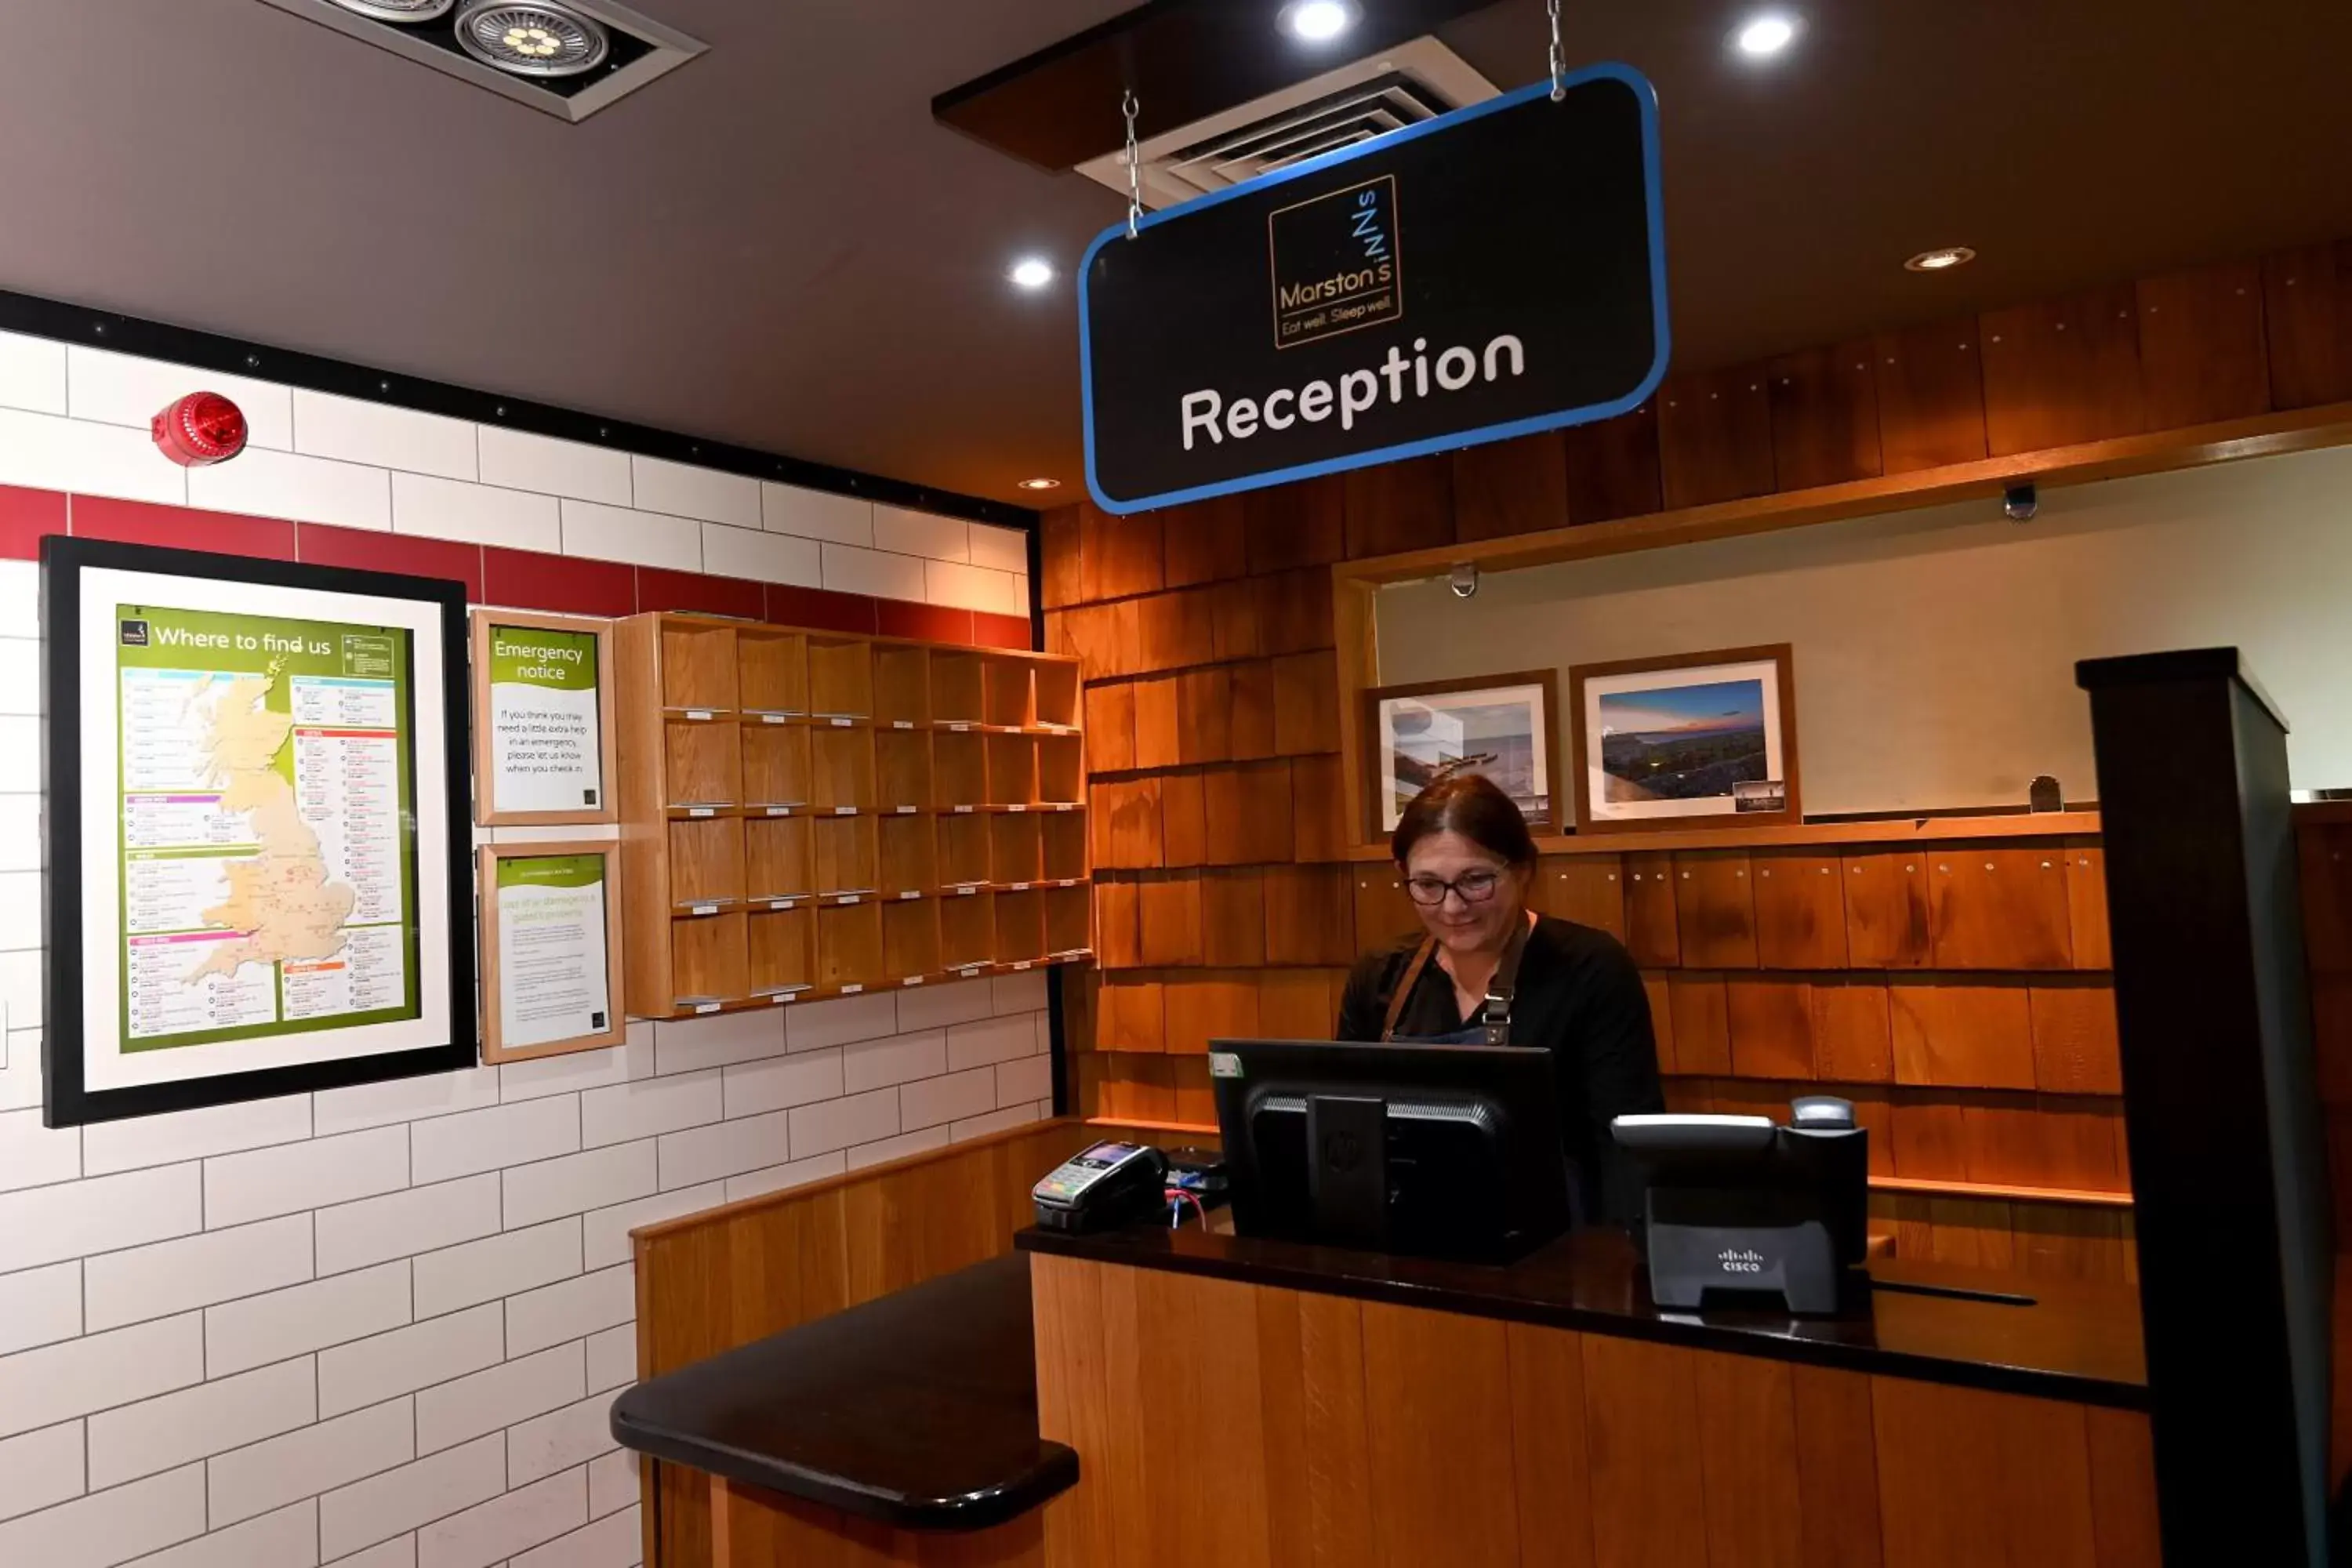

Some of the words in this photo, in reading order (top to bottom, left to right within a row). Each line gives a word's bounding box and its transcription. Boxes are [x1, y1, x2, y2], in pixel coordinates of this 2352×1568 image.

[1282, 321, 1301, 336] Eat
[1330, 303, 1366, 323] Sleep
[1181, 334, 1525, 451] Reception
[154, 626, 230, 649] Where
[236, 633, 258, 650] to
[263, 633, 303, 653] find
[309, 640, 332, 655] us
[495, 641, 583, 666] Emergency
[517, 664, 565, 680] notice
[501, 709, 508, 719] If
[509, 711, 526, 720] you
[550, 712, 565, 722] you
[498, 723, 520, 733] need
[528, 723, 546, 733] little
[548, 725, 569, 734] extra
[570, 724, 587, 735] help
[506, 750, 535, 760] please
[561, 751, 581, 760] know
[506, 764, 531, 773] when
[532, 765, 548, 774] you
